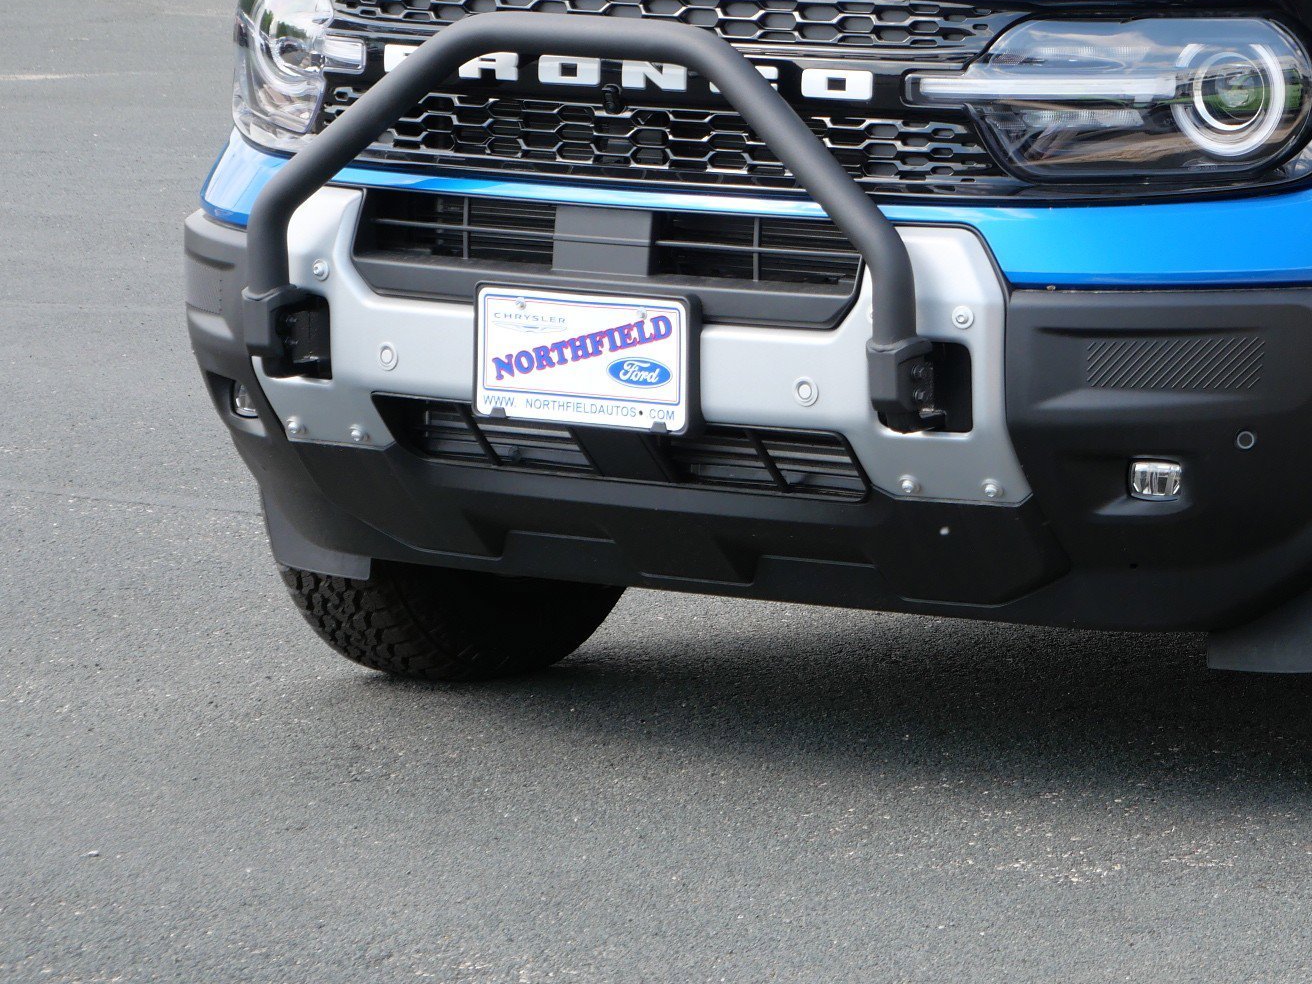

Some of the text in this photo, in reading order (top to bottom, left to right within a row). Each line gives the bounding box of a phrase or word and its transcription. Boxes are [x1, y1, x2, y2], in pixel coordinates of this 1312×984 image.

[493, 312, 566, 324] CHRYSLER
[491, 315, 673, 381] NORTHFIELD
[619, 360, 660, 383] Ford
